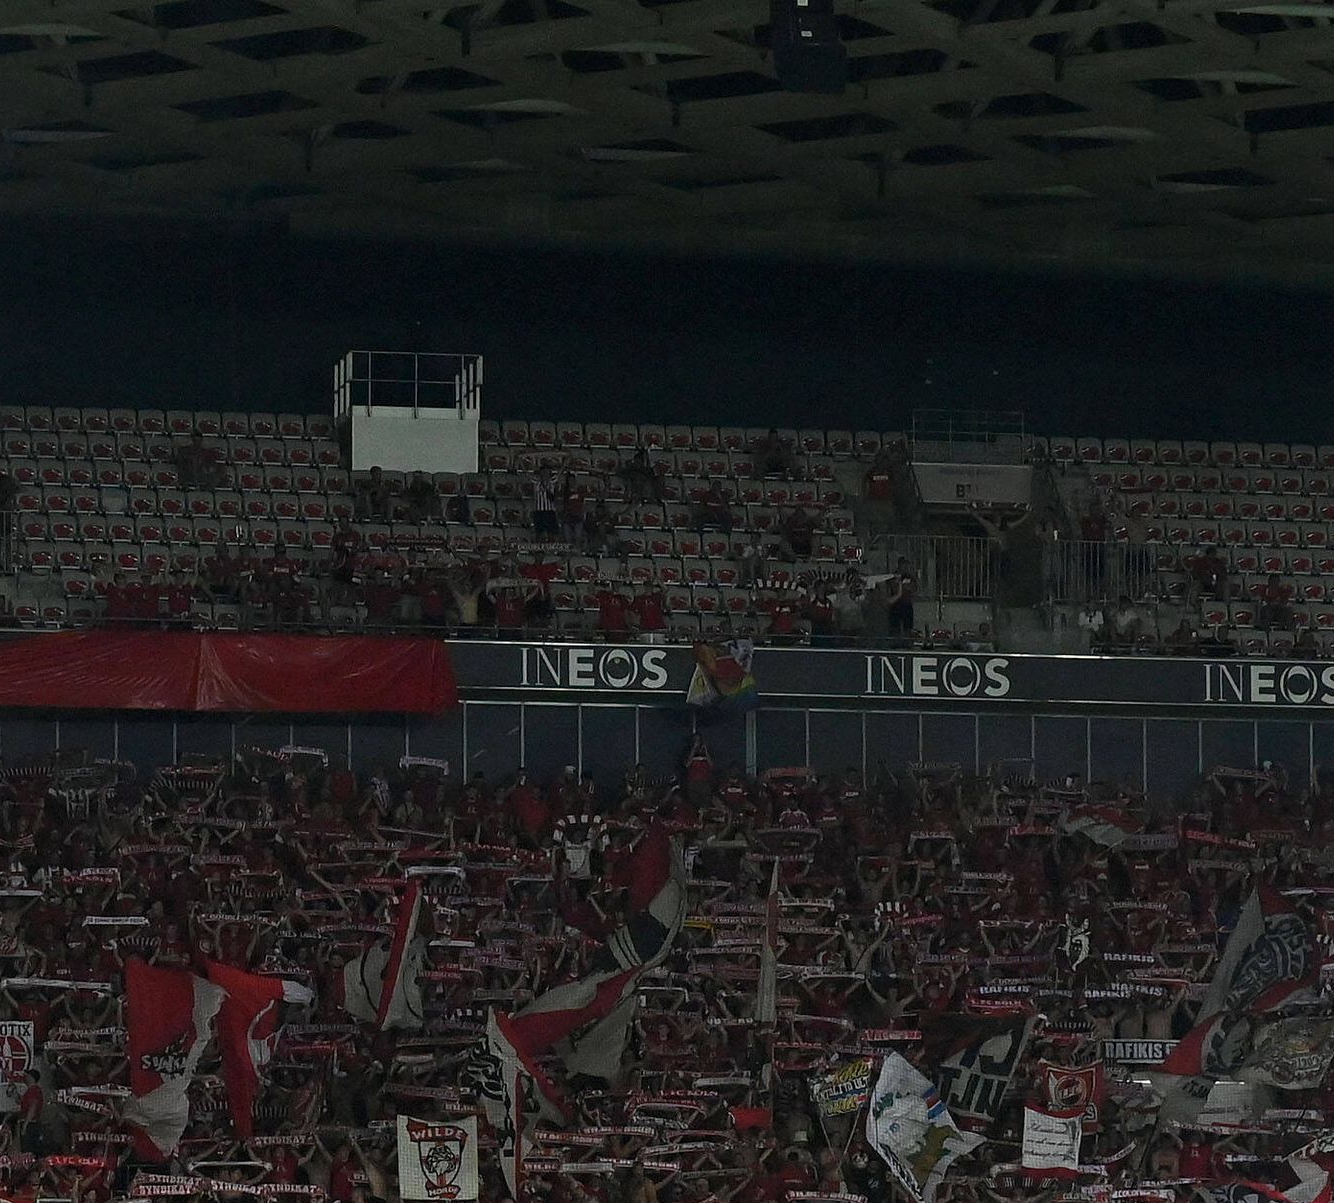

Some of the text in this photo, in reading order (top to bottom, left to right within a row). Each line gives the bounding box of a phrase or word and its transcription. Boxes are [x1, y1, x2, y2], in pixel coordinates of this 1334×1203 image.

[521, 646, 670, 690] INEOS
[865, 655, 1011, 698] INEOS
[1104, 1042, 1164, 1060] RAFIKIS
[411, 1126, 467, 1140] WILDE
